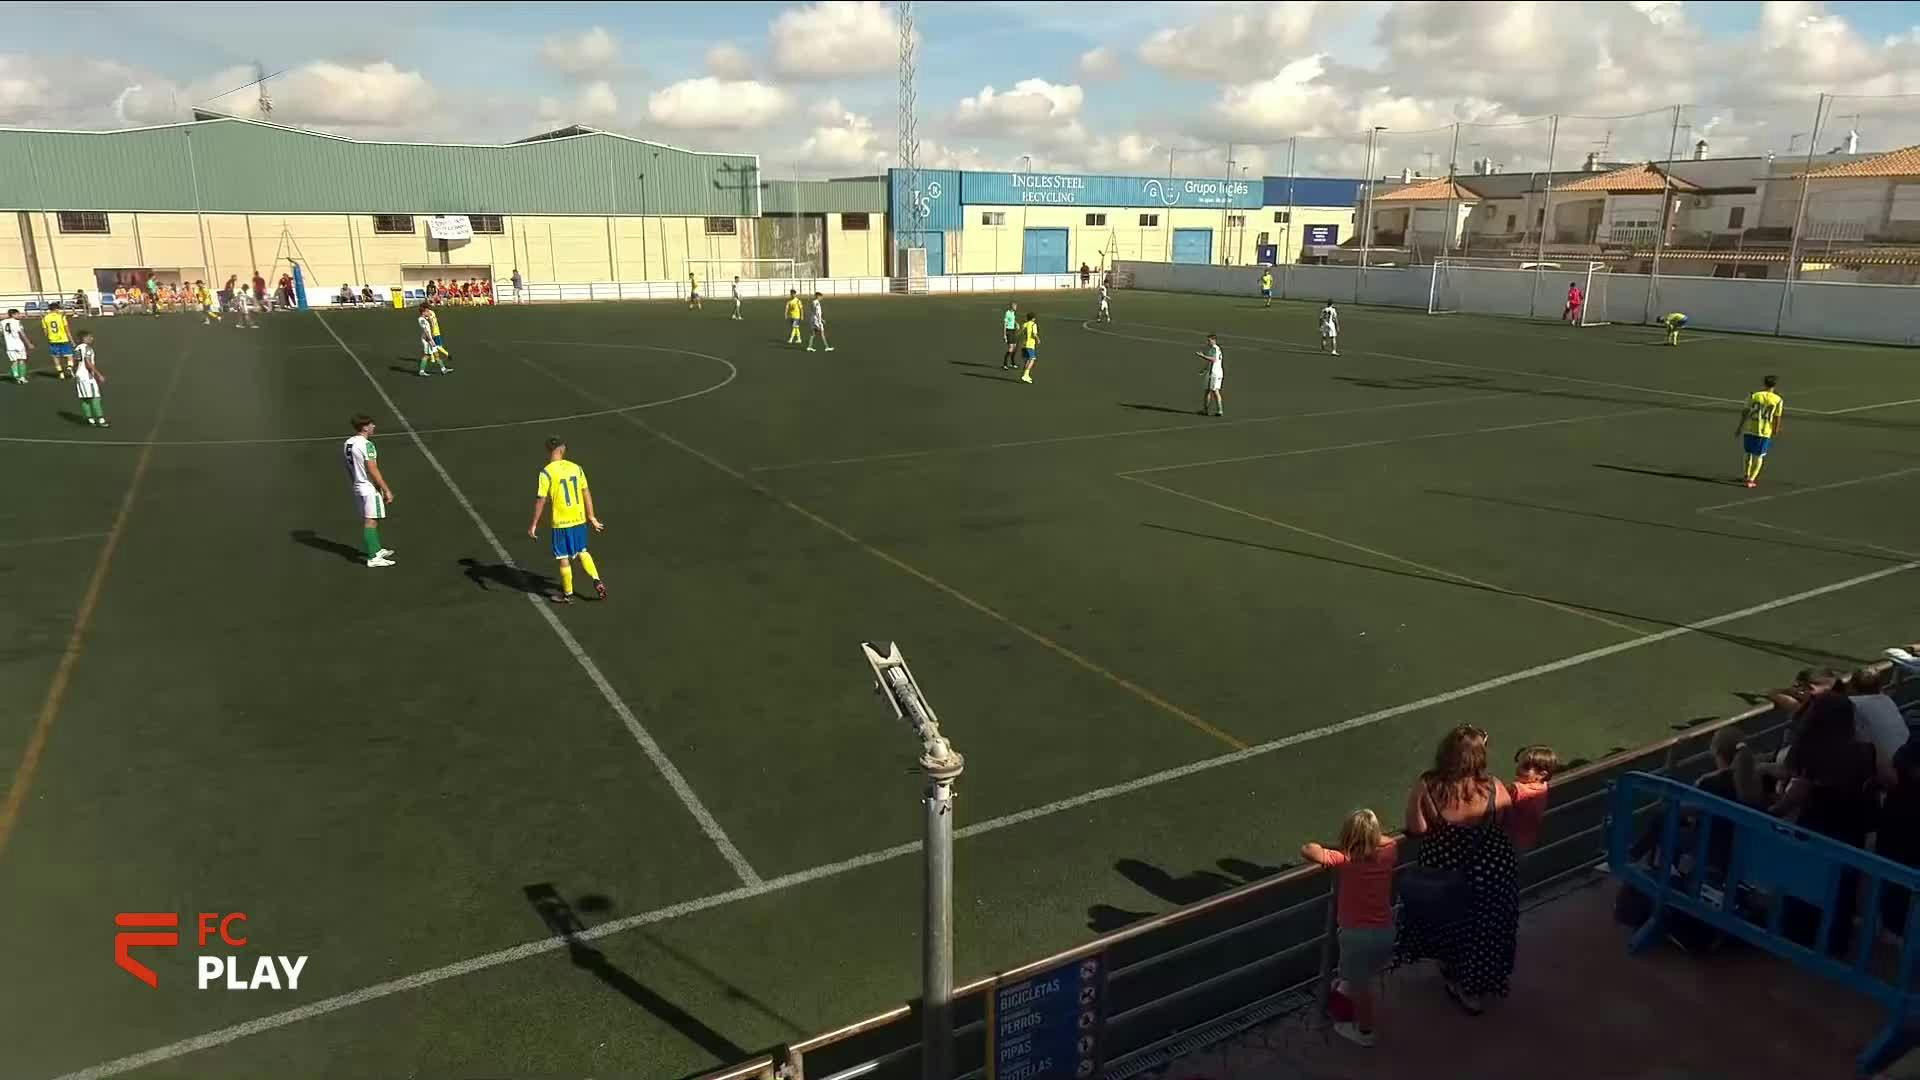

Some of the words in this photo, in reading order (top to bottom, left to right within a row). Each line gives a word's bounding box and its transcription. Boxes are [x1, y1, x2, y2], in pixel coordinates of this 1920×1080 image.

[1184, 181, 1217, 195] Grupo
[50, 321, 59, 334] 9
[560, 475, 579, 507] 11
[1000, 978, 1061, 1010] BICICLETAS
[1000, 1012, 1042, 1037] PERROS
[1000, 1040, 1032, 1062] PIPAS
